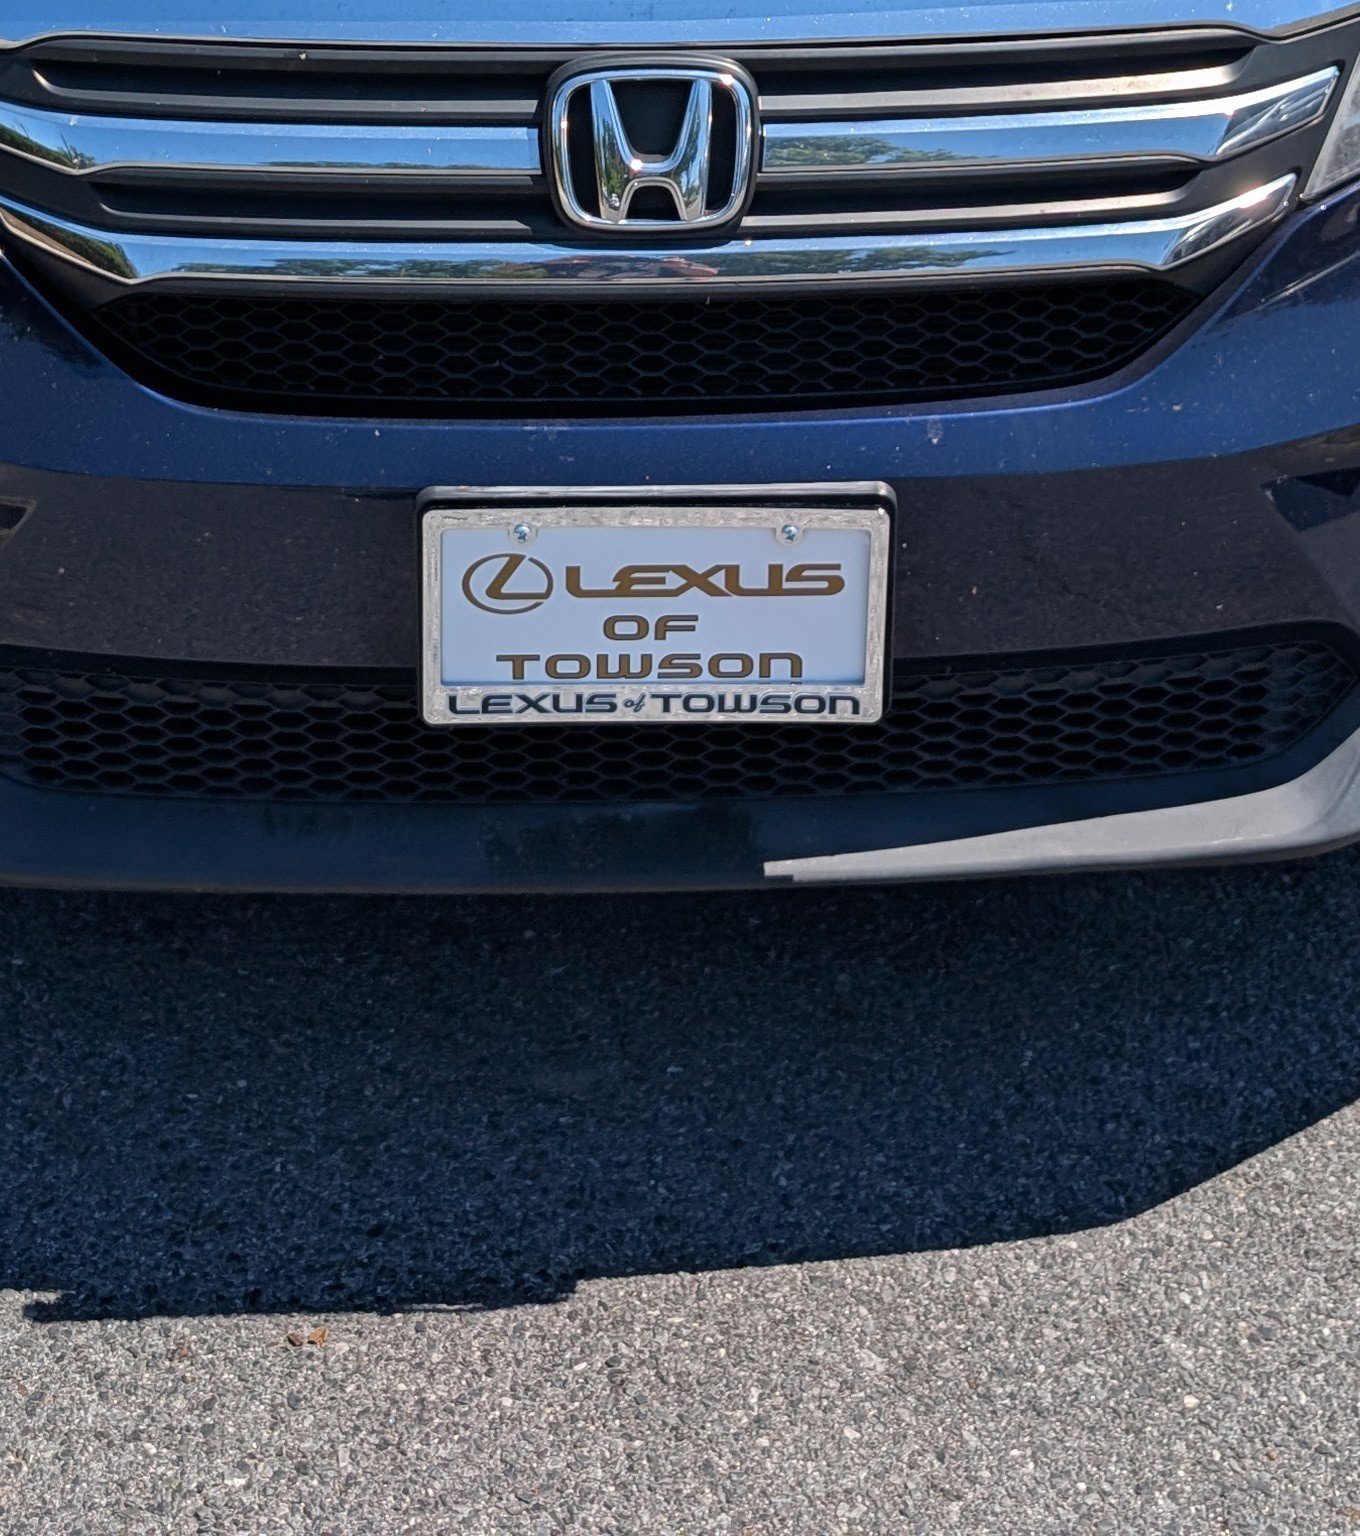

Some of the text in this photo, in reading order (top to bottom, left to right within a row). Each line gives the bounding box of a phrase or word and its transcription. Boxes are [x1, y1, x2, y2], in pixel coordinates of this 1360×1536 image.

[565, 563, 846, 598] LEXUS
[603, 614, 699, 641] OF
[496, 652, 804, 680] TOWSON
[448, 692, 860, 715] LEXUS of TOWSON
